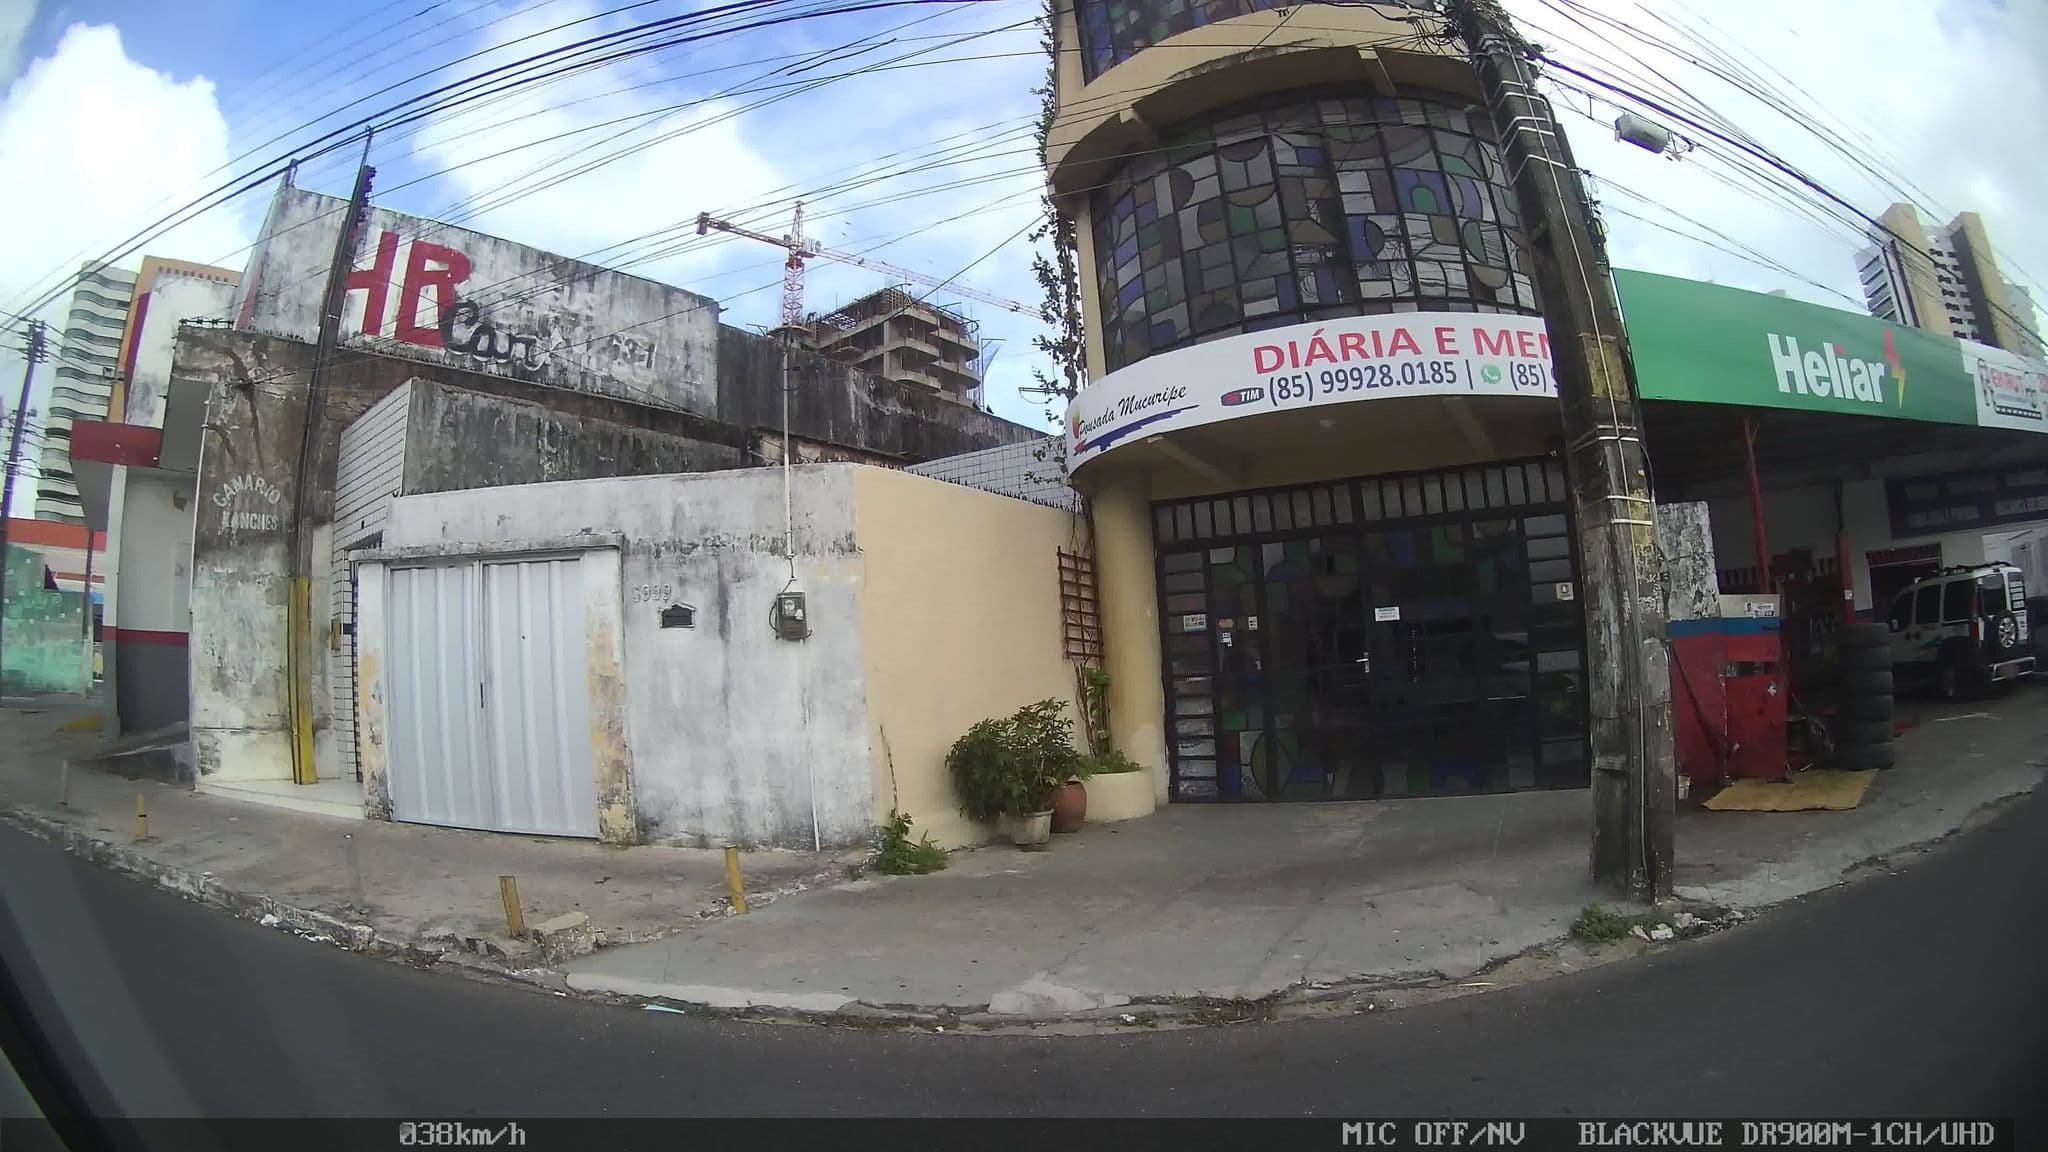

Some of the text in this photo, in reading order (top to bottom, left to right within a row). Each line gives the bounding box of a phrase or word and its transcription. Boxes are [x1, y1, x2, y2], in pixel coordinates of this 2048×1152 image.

[1253, 327, 1422, 375] DIÁRIA
[1434, 326, 1460, 355] E
[1766, 332, 1886, 403] Heliar
[1117, 385, 1188, 418] Mucuripe
[1239, 390, 1261, 403] TIM
[1269, 371, 1314, 407] (85)
[1319, 360, 1458, 395] 99928.0185
[1509, 360, 1547, 393] (85)
